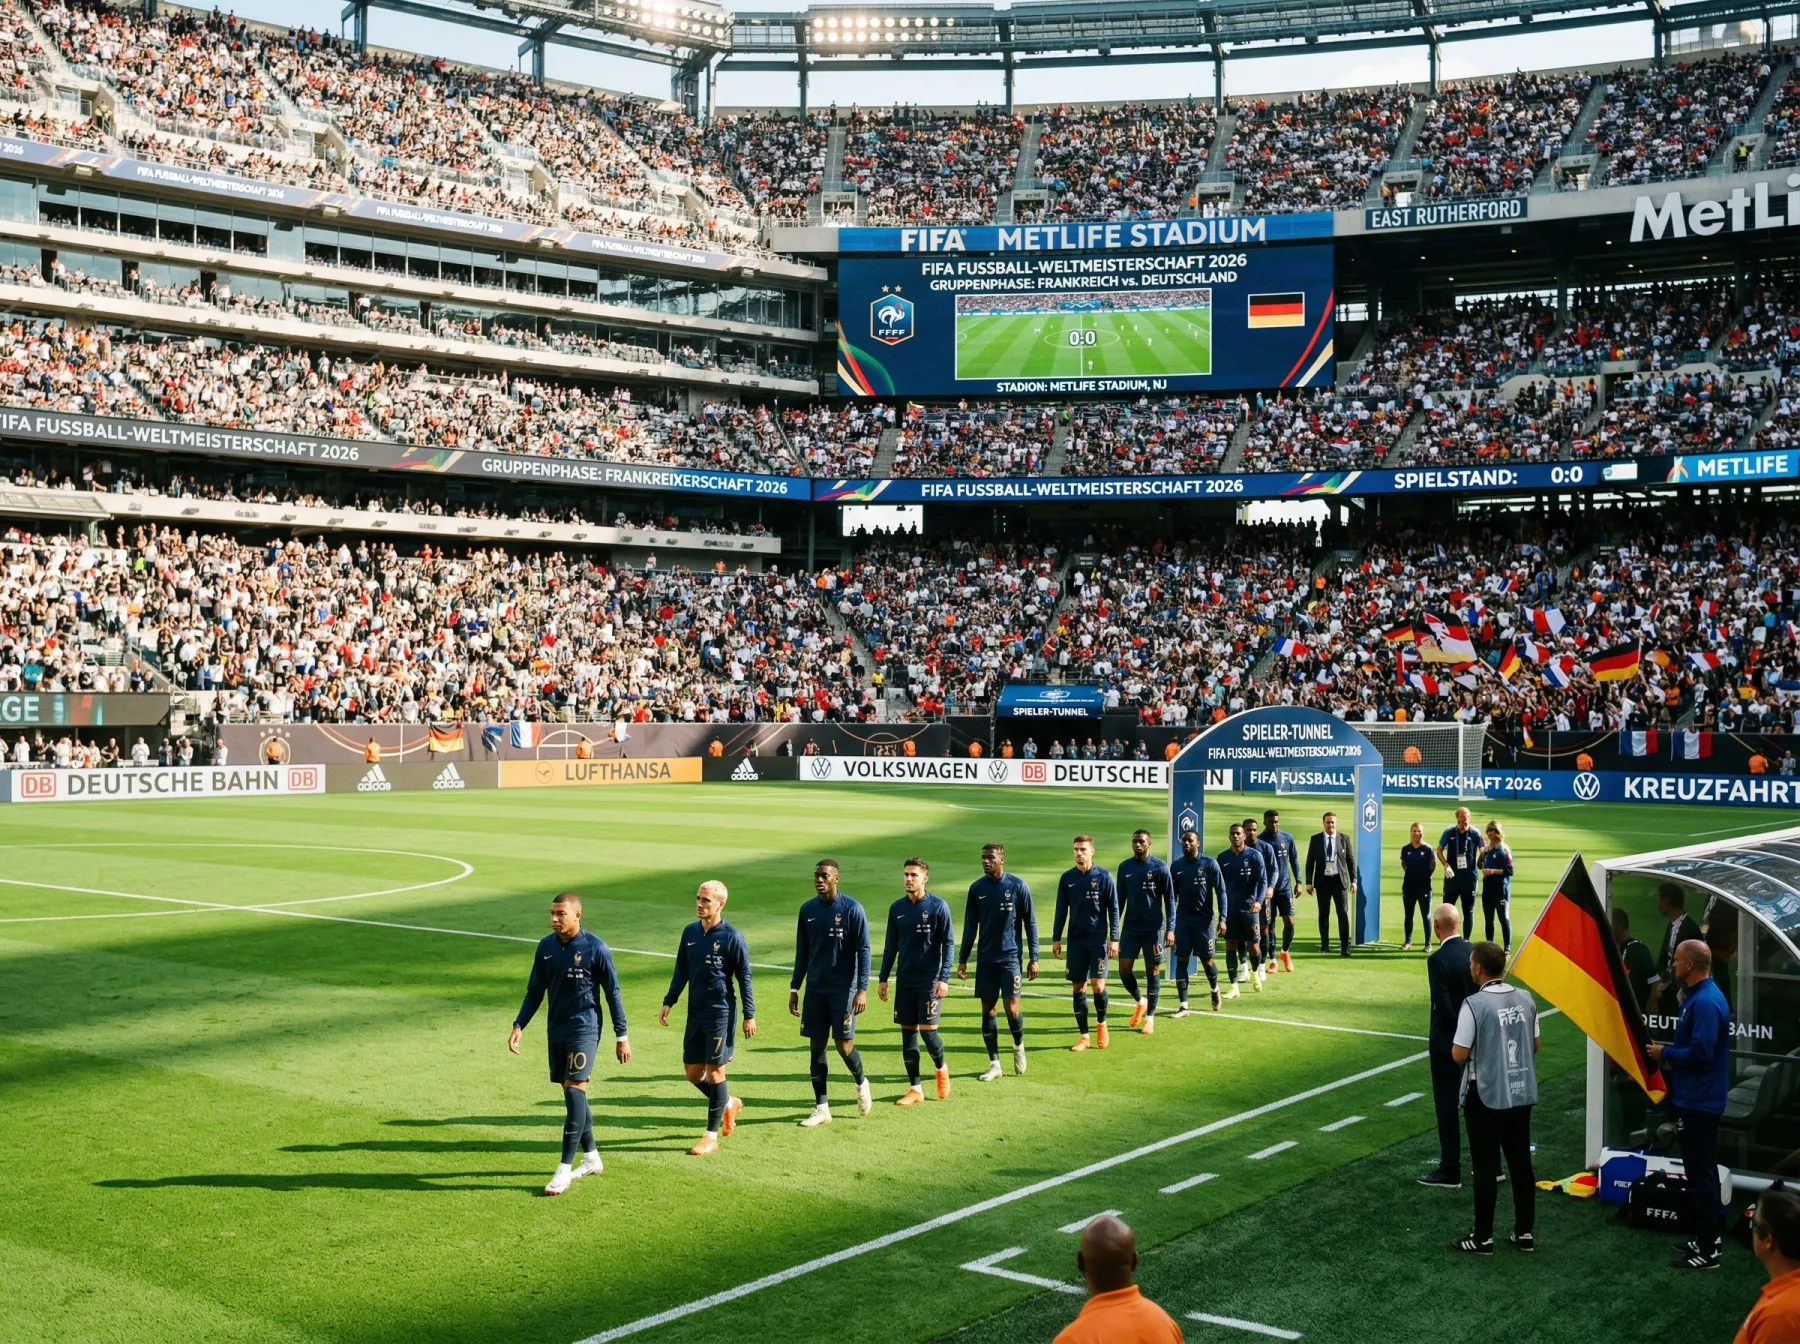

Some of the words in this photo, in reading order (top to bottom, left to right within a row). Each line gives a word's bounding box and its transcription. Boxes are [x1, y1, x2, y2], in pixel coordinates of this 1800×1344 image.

[1372, 208, 1411, 228] EAST
[1416, 200, 1521, 224] RUTHERFORD
[1630, 173, 1800, 242] MetLi
[998, 224, 1122, 251] METLIFE
[1129, 217, 1266, 248] STADIUM
[922, 262, 954, 276] FIFA
[958, 255, 1205, 275] FUSSBALL-WELTMEISTERSCHAFT
[1208, 254, 1247, 268] 2026
[930, 277, 1035, 291] GRUPPENPHASE:
[1037, 275, 1119, 289] FRANKREICH
[1122, 277, 1139, 287] vs.
[1141, 271, 1237, 286] DEUTSCHLAND
[1069, 330, 1096, 346] 0:0
[996, 382, 1048, 393] STADION:
[1050, 381, 1095, 392] METLIFE
[1098, 379, 1151, 392] STADIUM,
[1153, 379, 1168, 390] NJ
[0, 414, 32, 431] IFA
[36, 417, 317, 457] FUSSBALL-WELTMEISTERSCHAFT
[320, 444, 360, 461] 2026
[1697, 454, 1788, 477] METLIFE
[481, 458, 602, 481] GRUPPENPHASE:
[755, 480, 788, 495] 2026
[1394, 469, 1518, 489] SPIELSTAND:
[1550, 466, 1583, 484] 0:0
[921, 483, 954, 497] FIFA
[957, 480, 1203, 497] FUSSBALL-WELTMEISTERSCHAFT
[1205, 479, 1244, 493] 2026
[0, 696, 39, 722] GE
[1013, 707, 1088, 716] SPIELER-TUNNEL
[1242, 724, 1333, 741] SPIELER-TUNNEL
[1208, 748, 1226, 759] FIFA
[1227, 746, 1345, 759] FUSSBALL-WELTMEISTERSCHAFT
[565, 761, 671, 781] LUFTHANSA
[844, 761, 978, 780] VOLKSWAGEN
[1023, 764, 1045, 780] DB
[1055, 764, 1158, 783] DEUTSCHE
[24, 776, 54, 795] DB
[67, 771, 204, 796] DEUTSCHE
[211, 769, 279, 791] BAHN
[289, 769, 316, 788] DB
[1250, 771, 1278, 784] FIFA
[1504, 777, 1542, 791] 2026
[712, 1037, 723, 1054] 7
[568, 1052, 587, 1071] 10
